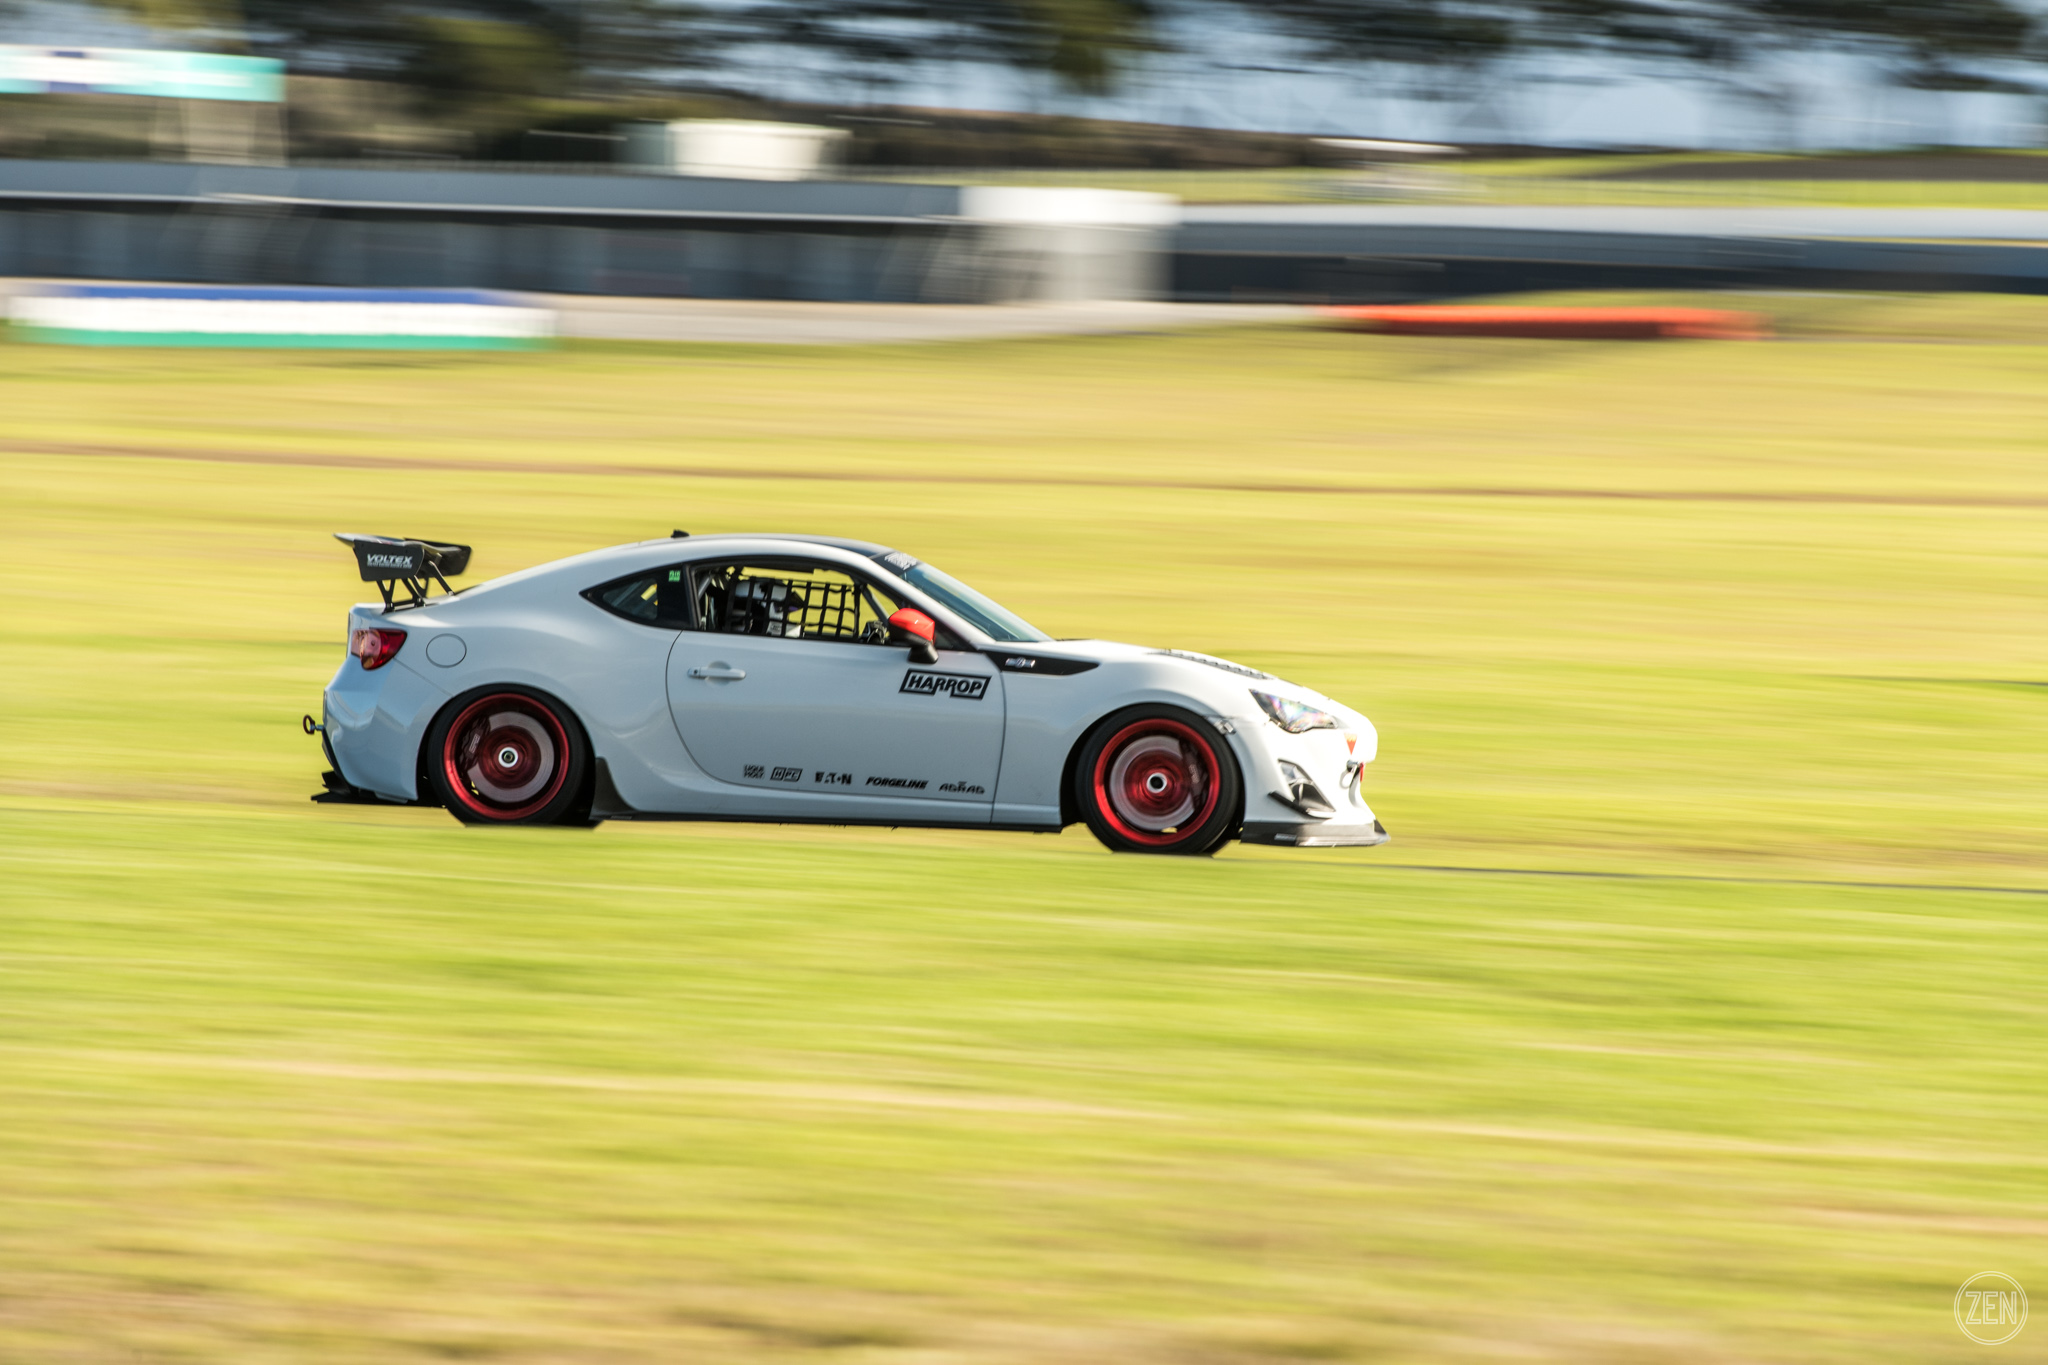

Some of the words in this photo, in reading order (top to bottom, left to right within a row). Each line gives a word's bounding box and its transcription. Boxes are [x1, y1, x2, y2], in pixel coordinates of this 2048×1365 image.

[367, 554, 413, 565] VOLTEX
[906, 673, 985, 697] HARROP
[865, 776, 929, 790] FORGELINE
